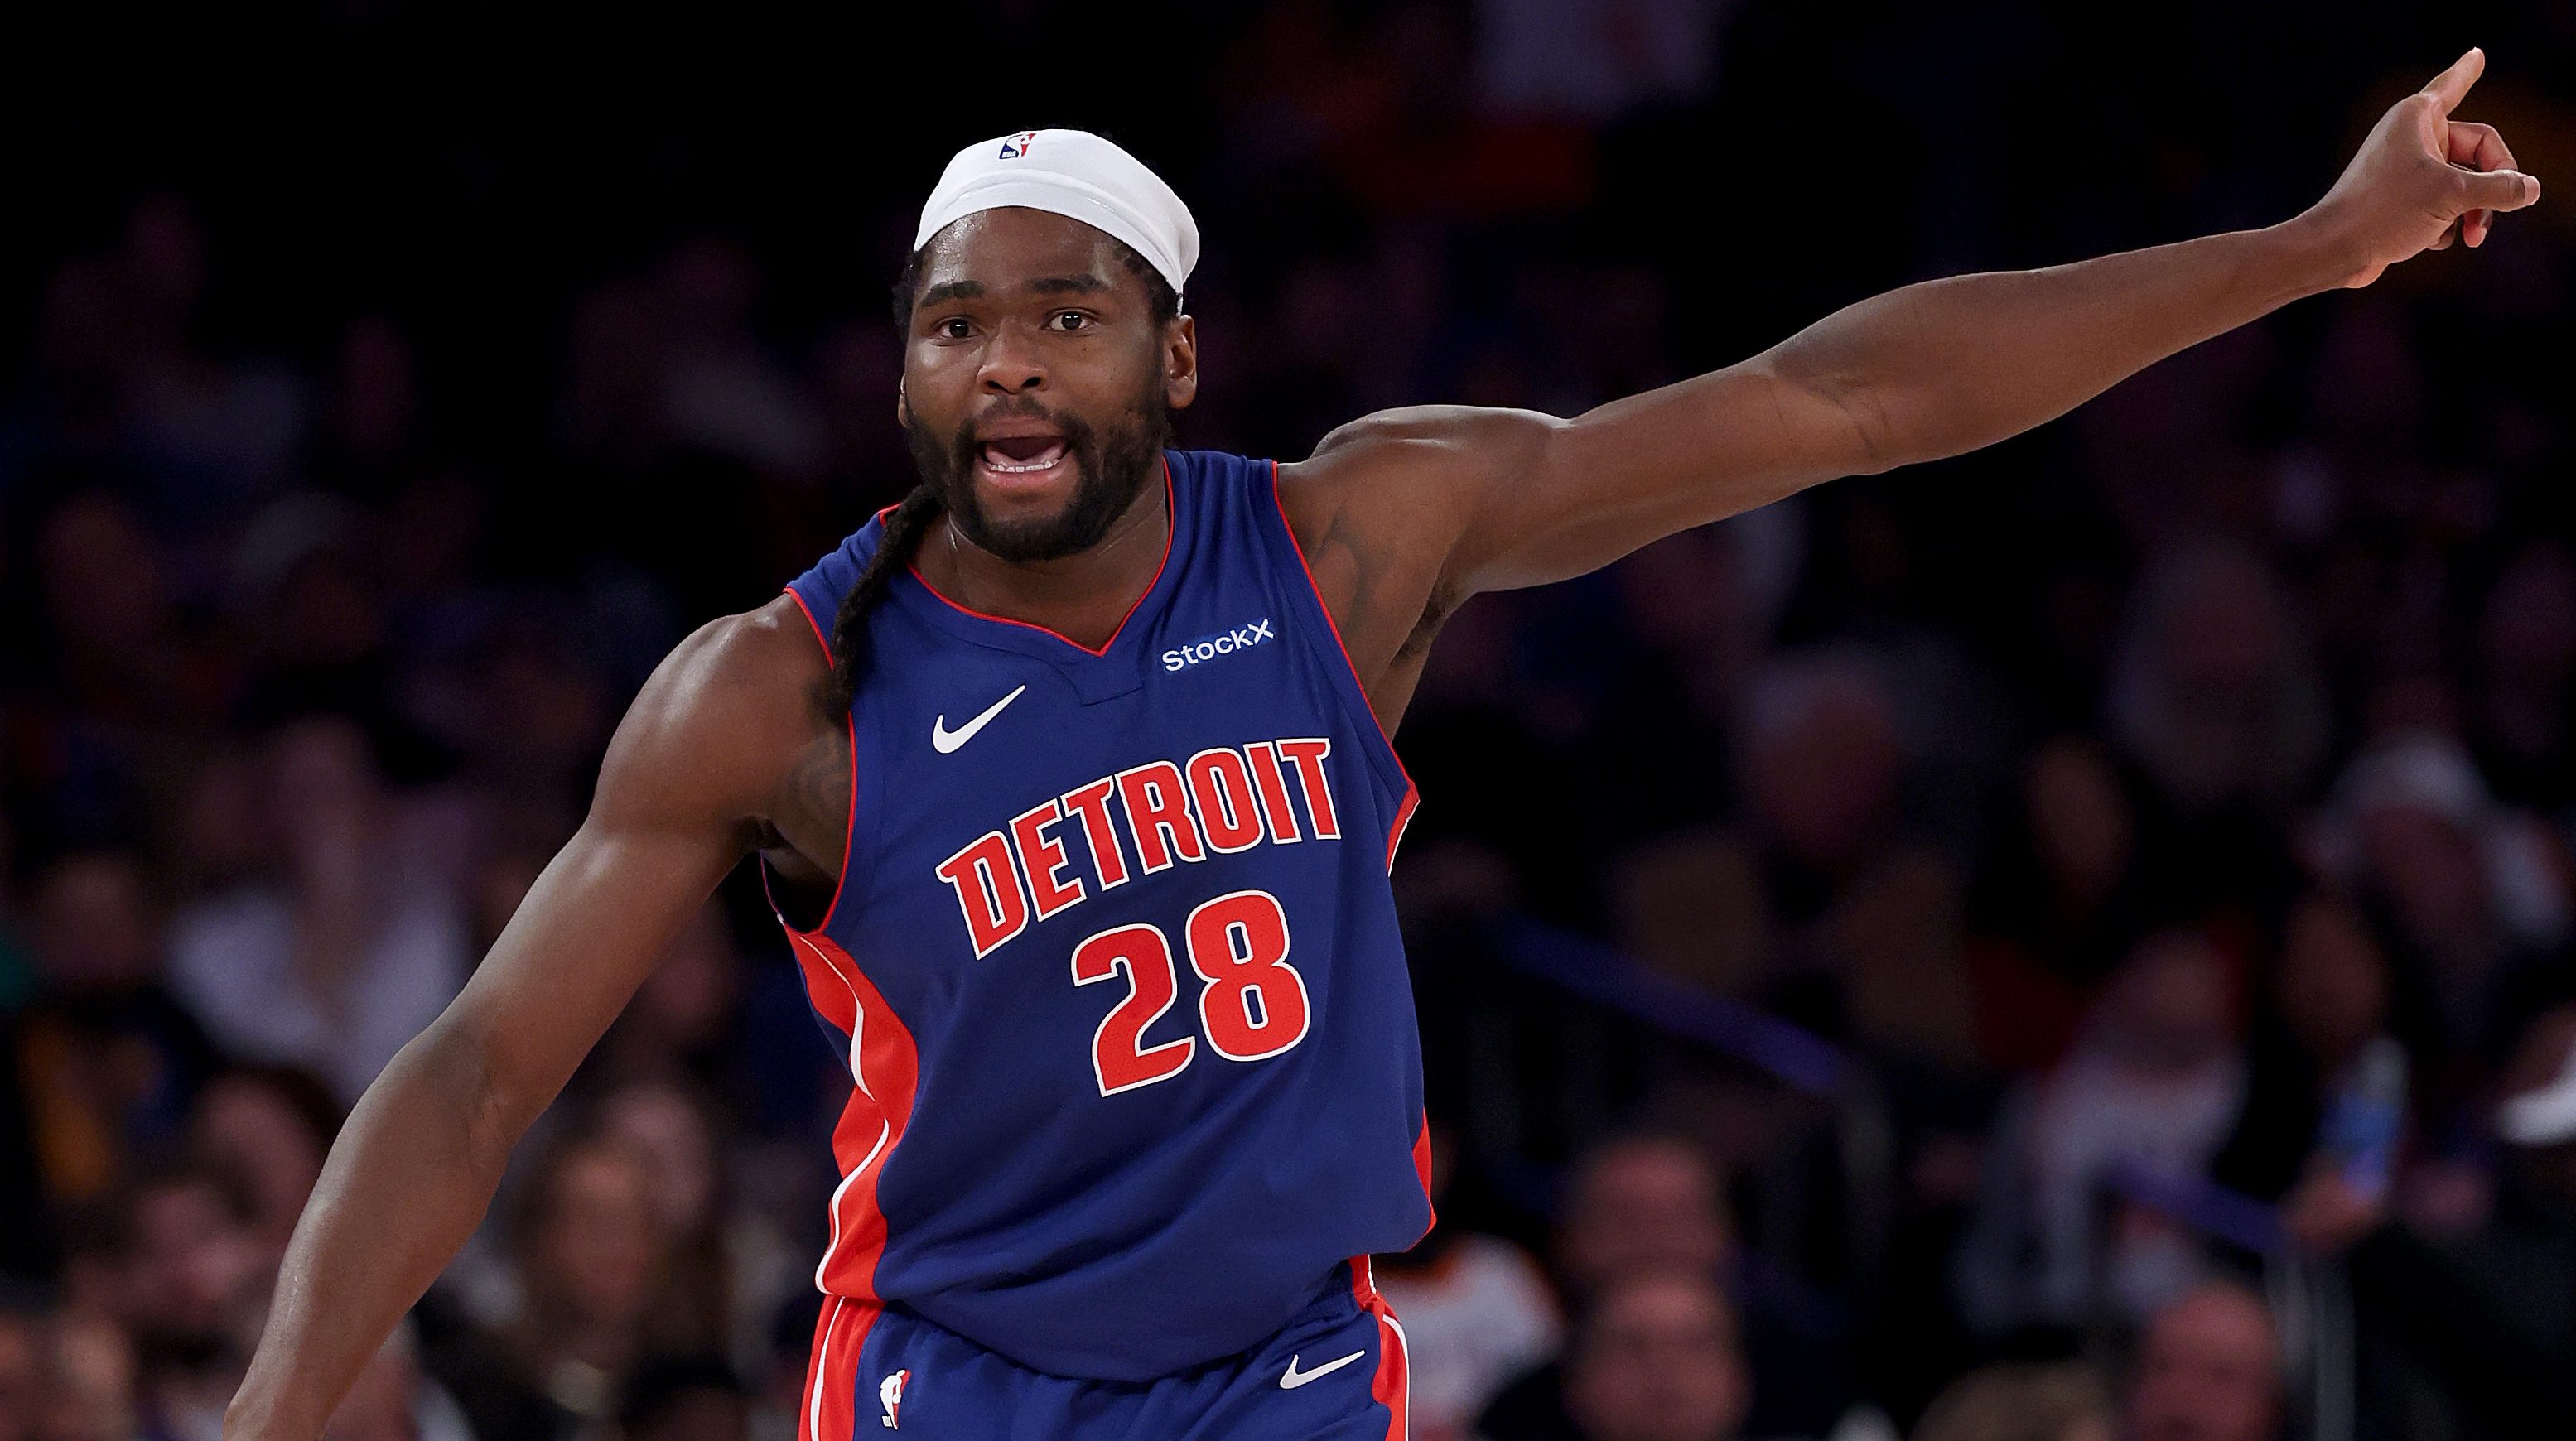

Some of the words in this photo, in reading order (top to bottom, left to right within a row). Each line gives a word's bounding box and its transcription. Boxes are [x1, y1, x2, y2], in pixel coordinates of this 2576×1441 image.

[1161, 618, 1274, 672] StockX
[935, 738, 1342, 961] DETROIT
[1071, 889, 1311, 1097] 28
